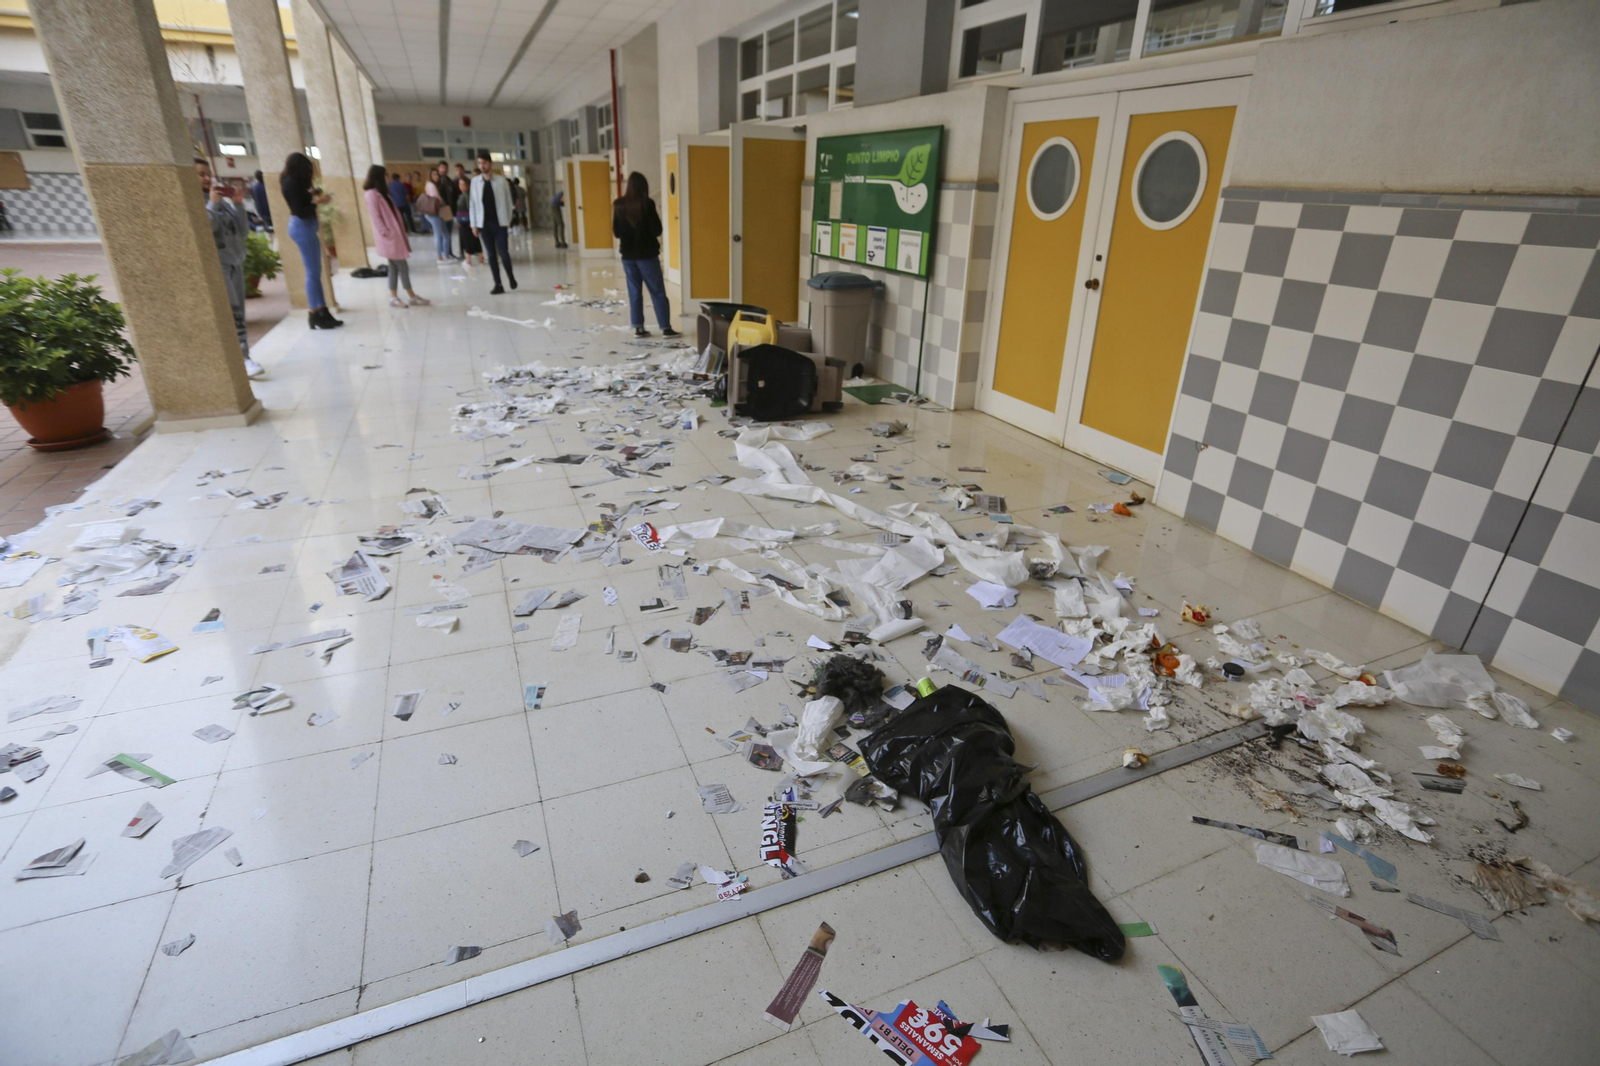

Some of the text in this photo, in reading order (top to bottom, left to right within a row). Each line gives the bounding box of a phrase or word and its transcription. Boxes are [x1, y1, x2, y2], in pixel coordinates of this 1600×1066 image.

[846, 149, 900, 163] PUNTO LIMPIO
[878, 1022, 891, 1036] B1
[899, 1020, 945, 1061] SEMANALES
[907, 1007, 963, 1057] 59€
[890, 1035, 915, 1058] DELF
